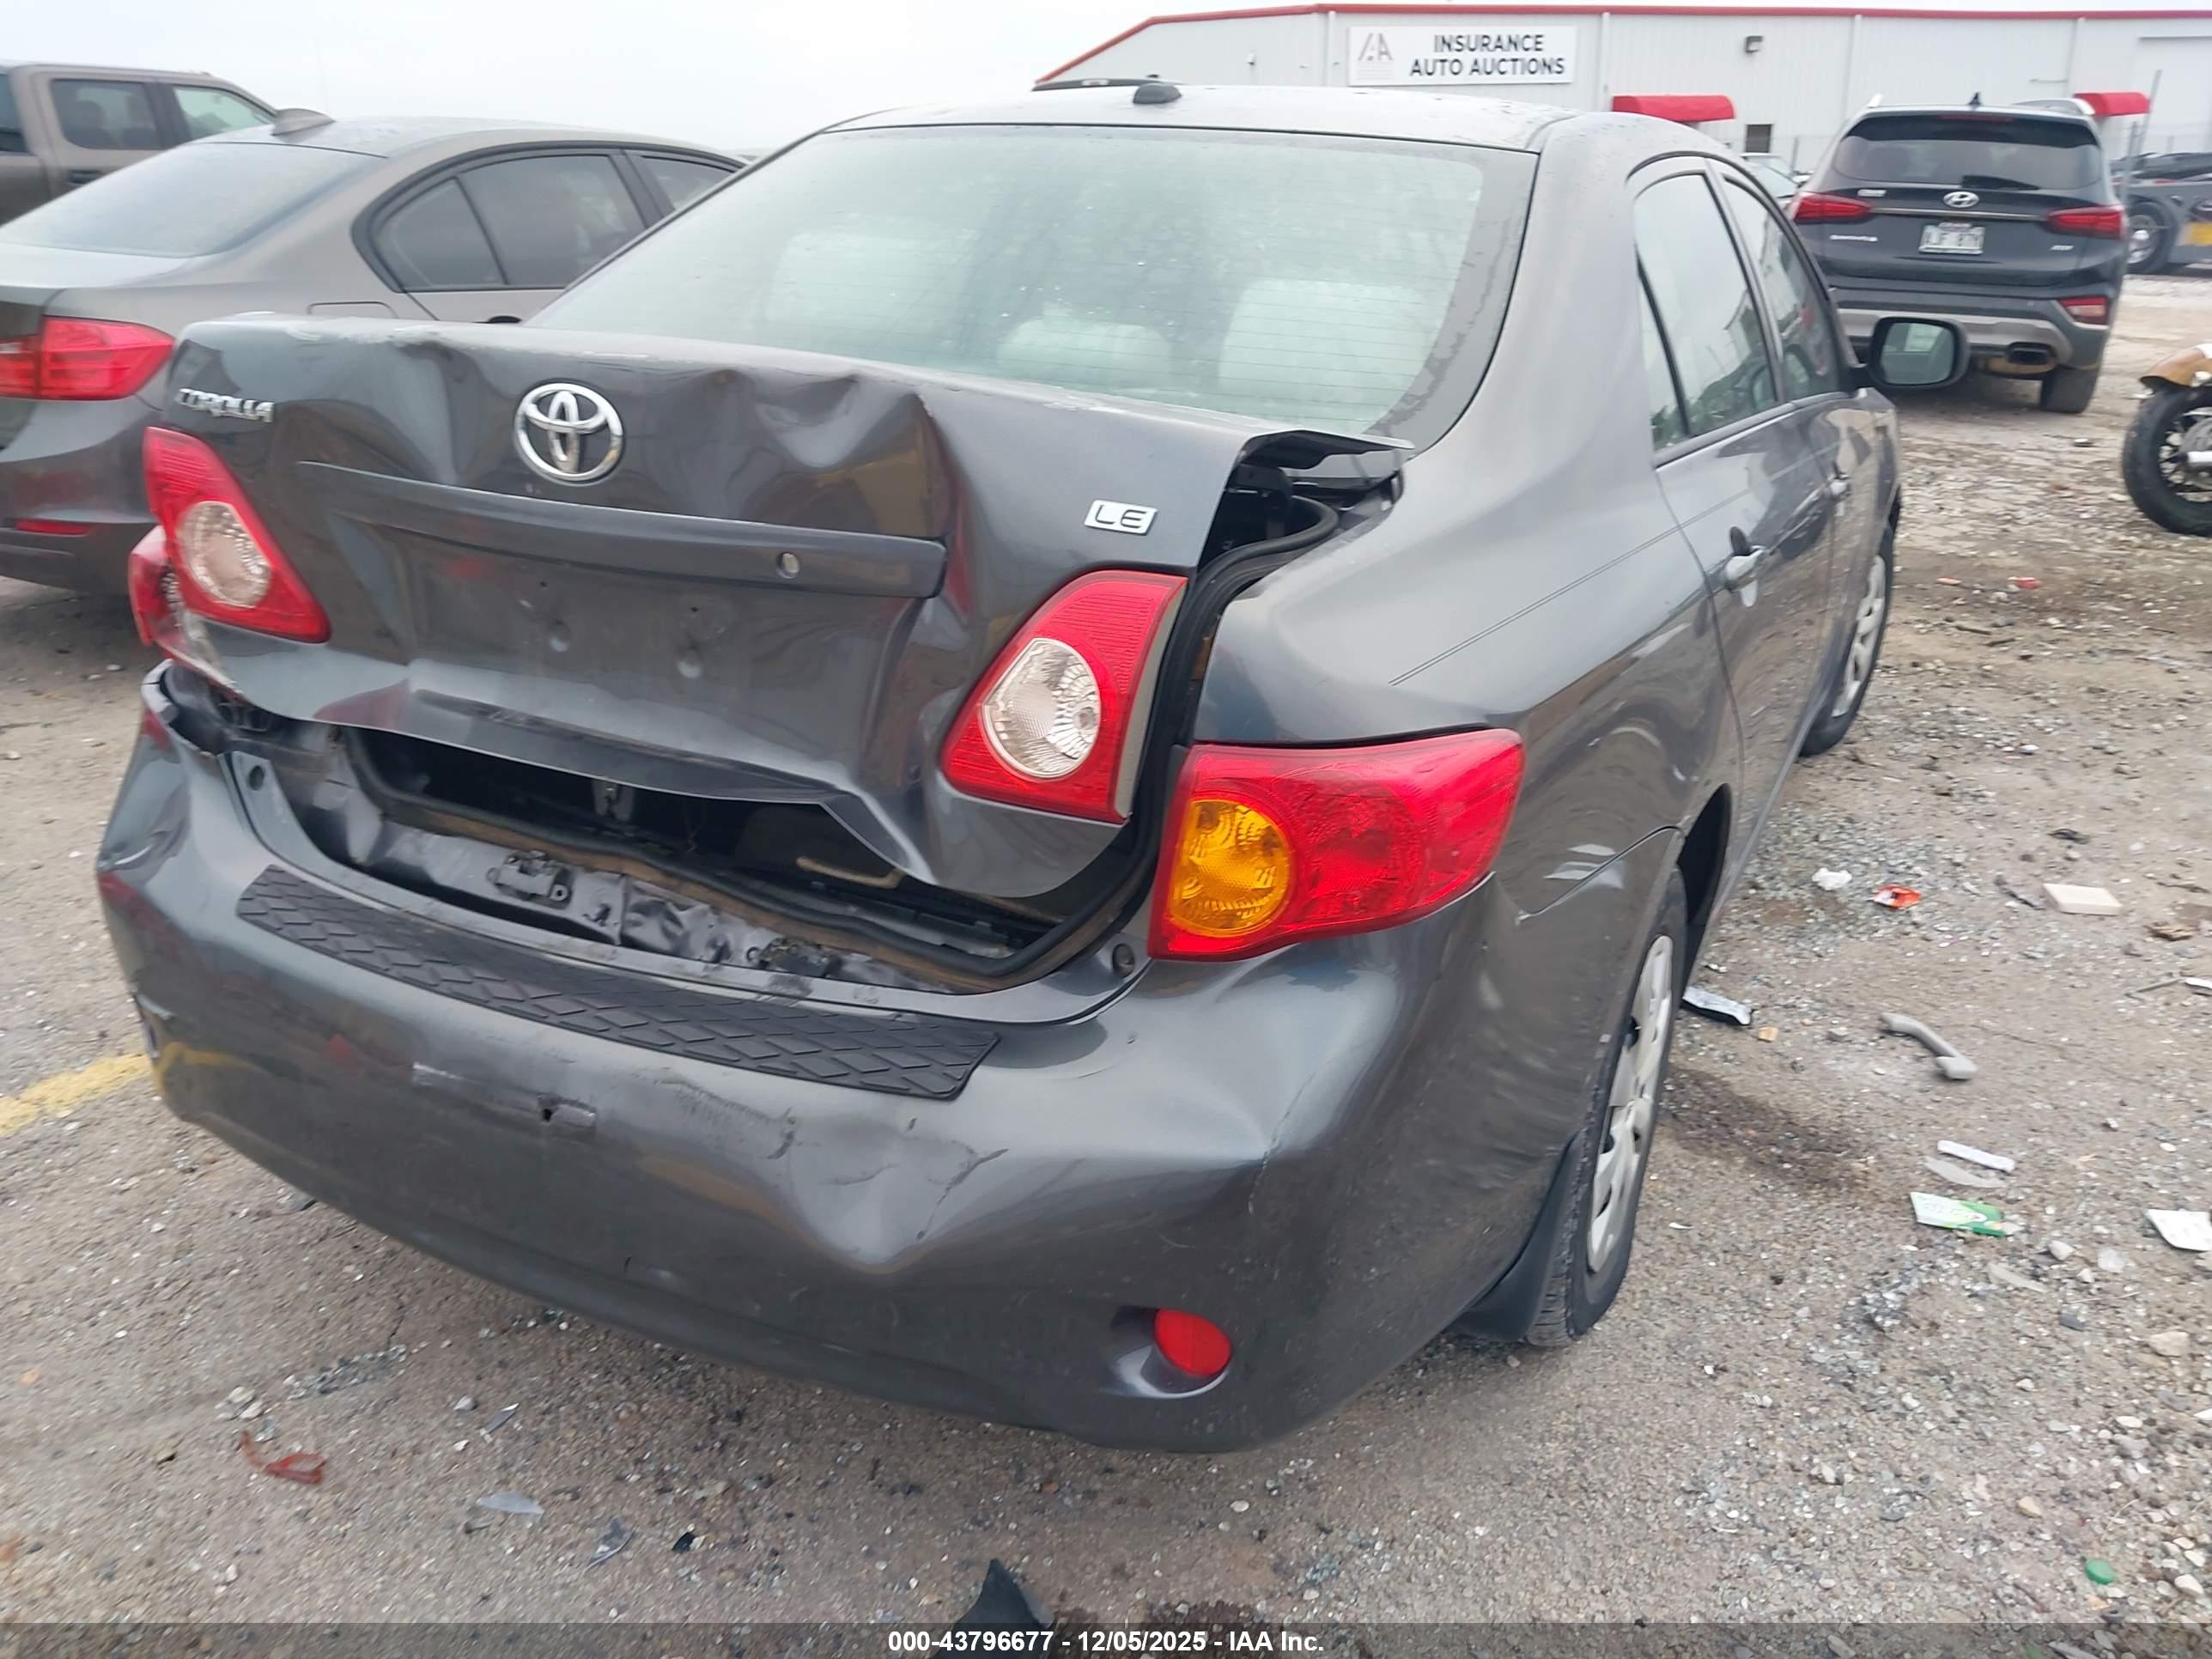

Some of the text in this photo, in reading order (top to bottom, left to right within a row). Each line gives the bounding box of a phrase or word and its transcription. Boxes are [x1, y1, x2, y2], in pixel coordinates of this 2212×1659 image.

[1433, 34, 1545, 52] INSURANCE
[1409, 58, 1565, 76] AUTO AUCTIONS
[1091, 502, 1152, 532] LE
